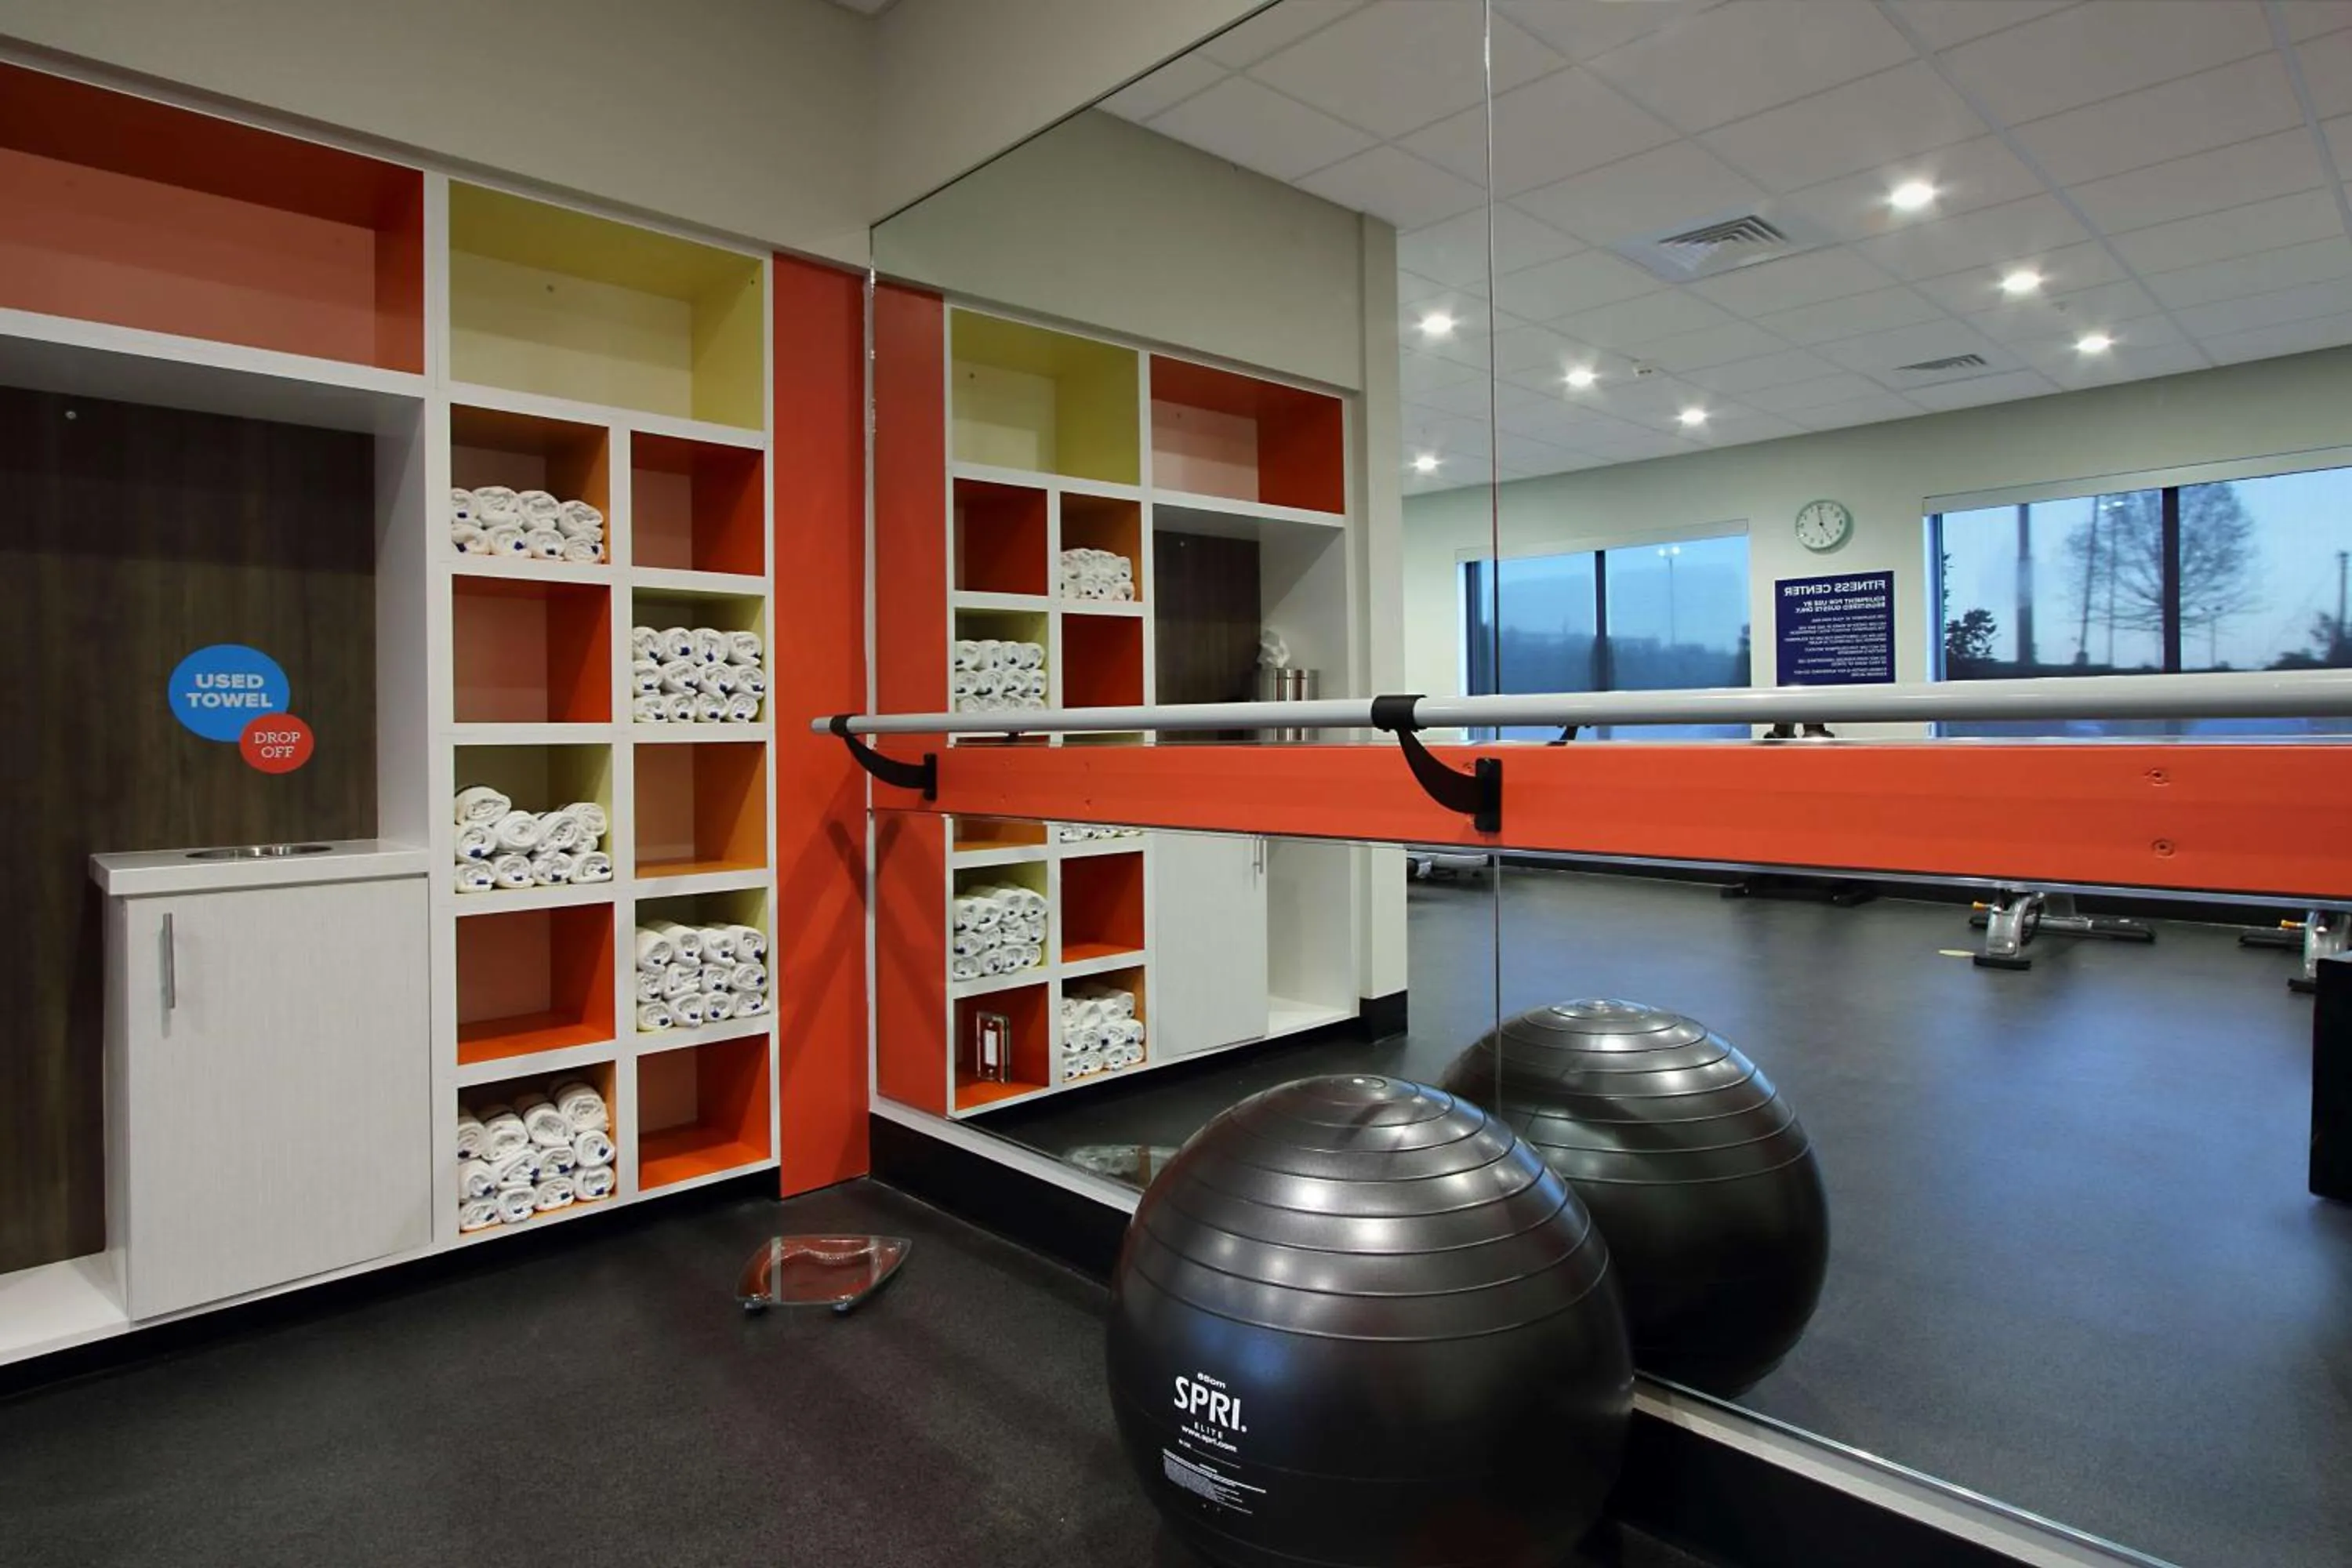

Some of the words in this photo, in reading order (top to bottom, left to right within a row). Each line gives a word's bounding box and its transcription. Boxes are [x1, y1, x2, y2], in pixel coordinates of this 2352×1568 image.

[194, 673, 264, 689] USED
[186, 692, 274, 708] TOWEL
[253, 731, 302, 744] DROP
[260, 746, 295, 758] OFF
[1194, 1421, 1223, 1440] ELITE
